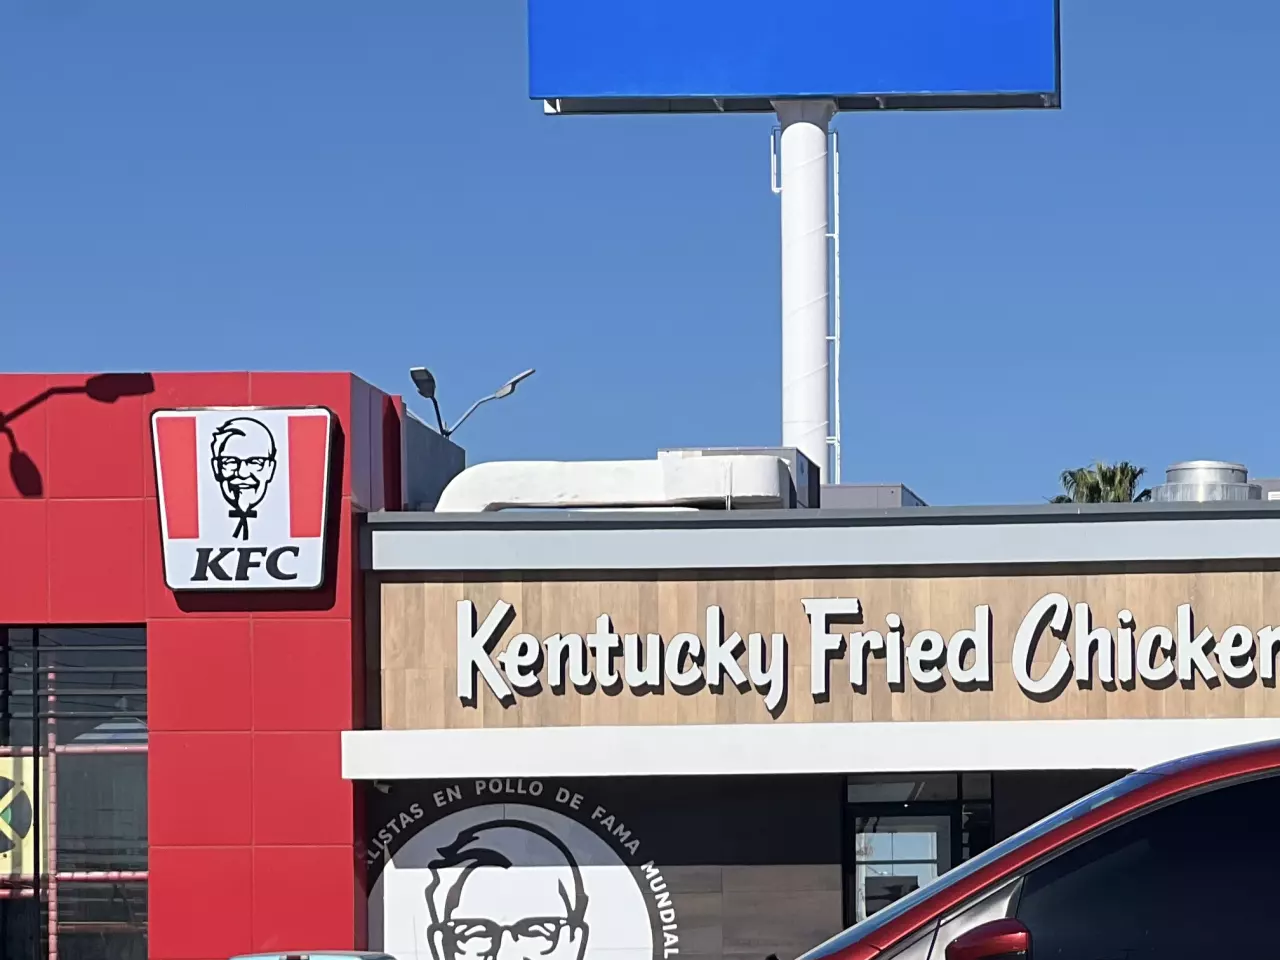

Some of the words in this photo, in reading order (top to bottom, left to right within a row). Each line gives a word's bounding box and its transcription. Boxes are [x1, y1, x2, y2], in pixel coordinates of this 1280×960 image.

[190, 545, 300, 582] KFC
[456, 599, 788, 717] Kentucky
[800, 597, 993, 702] Fried
[433, 784, 462, 808] EN
[475, 778, 544, 796] POLLO
[555, 787, 584, 810] DE
[591, 805, 641, 856] FAMA
[640, 860, 680, 960] MUNDIAL
